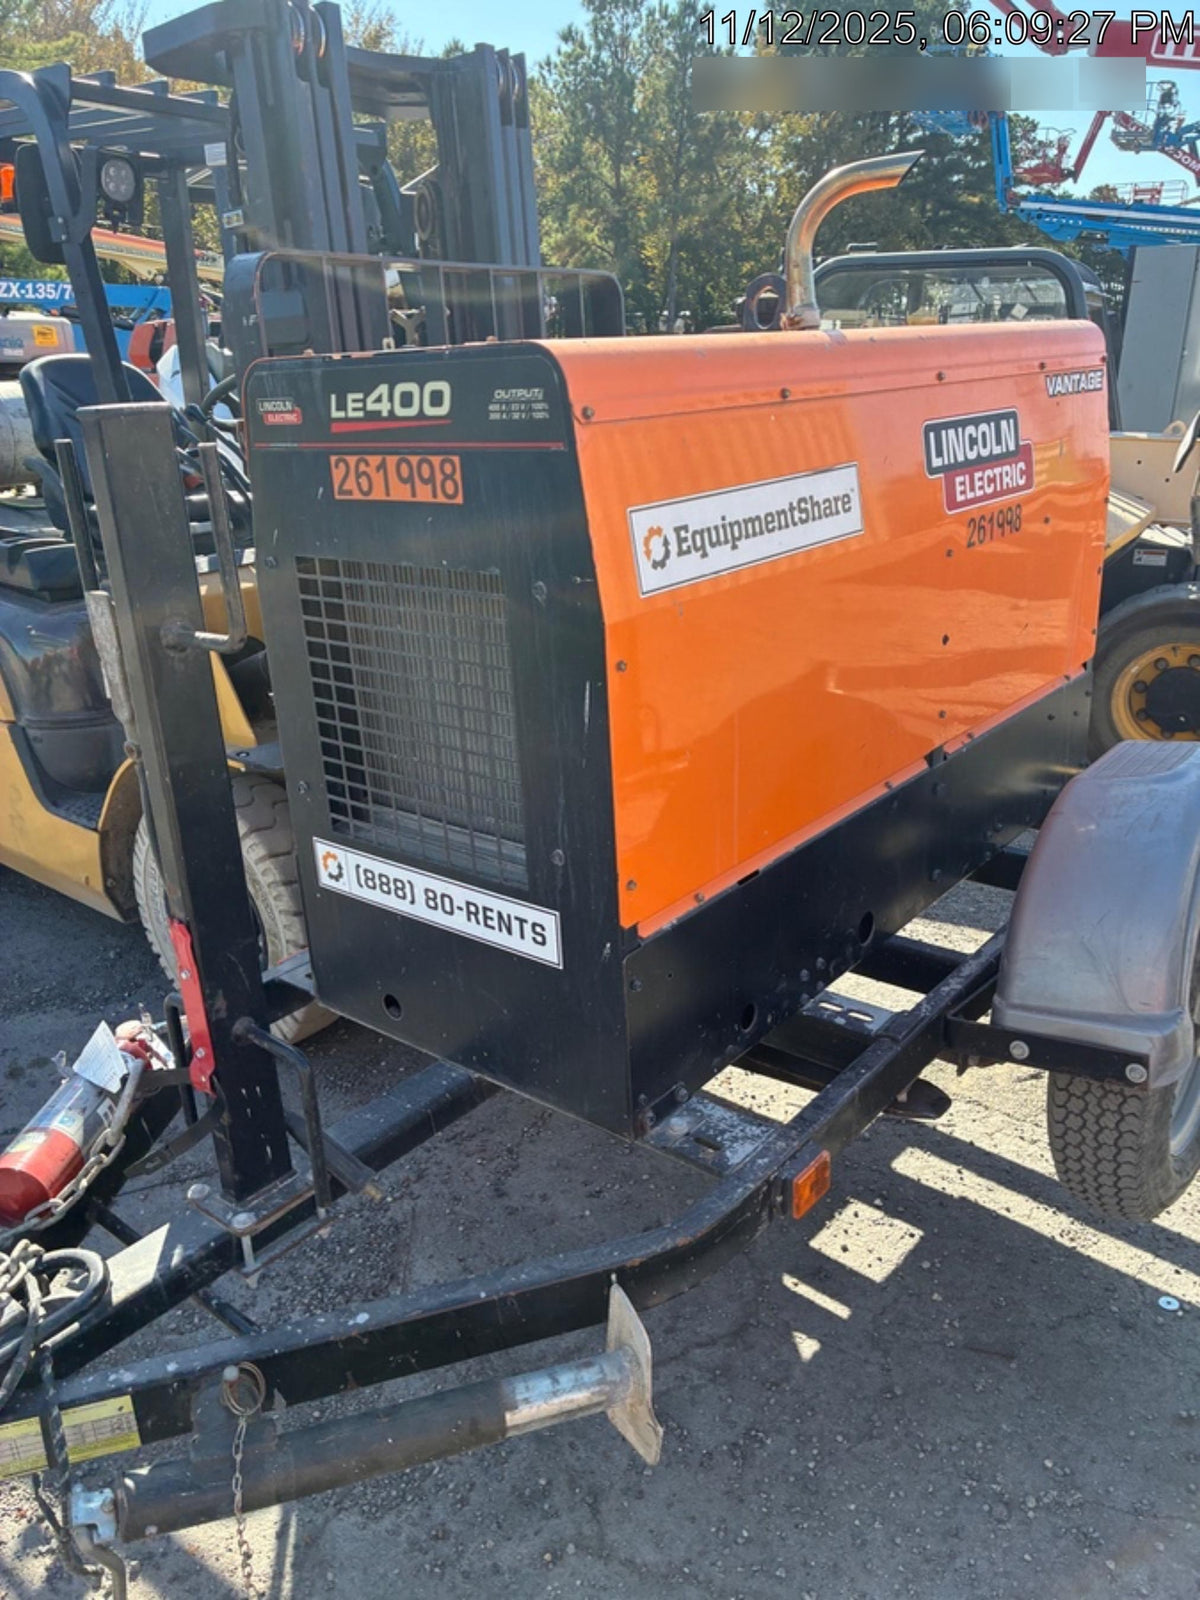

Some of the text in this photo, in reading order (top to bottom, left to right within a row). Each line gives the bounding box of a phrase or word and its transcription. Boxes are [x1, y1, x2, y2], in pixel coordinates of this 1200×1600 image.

[330, 381, 451, 418] LE400
[1046, 371, 1103, 396] VANTAGE
[259, 402, 292, 412] LINCOLN
[929, 418, 1015, 468] LINCOLN
[334, 457, 460, 500] 261998
[955, 461, 1026, 502] ELECTRIC
[673, 494, 852, 559] EquipmentShare
[966, 504, 1023, 548] 261998
[355, 863, 547, 947] (888) 80-RENTS
